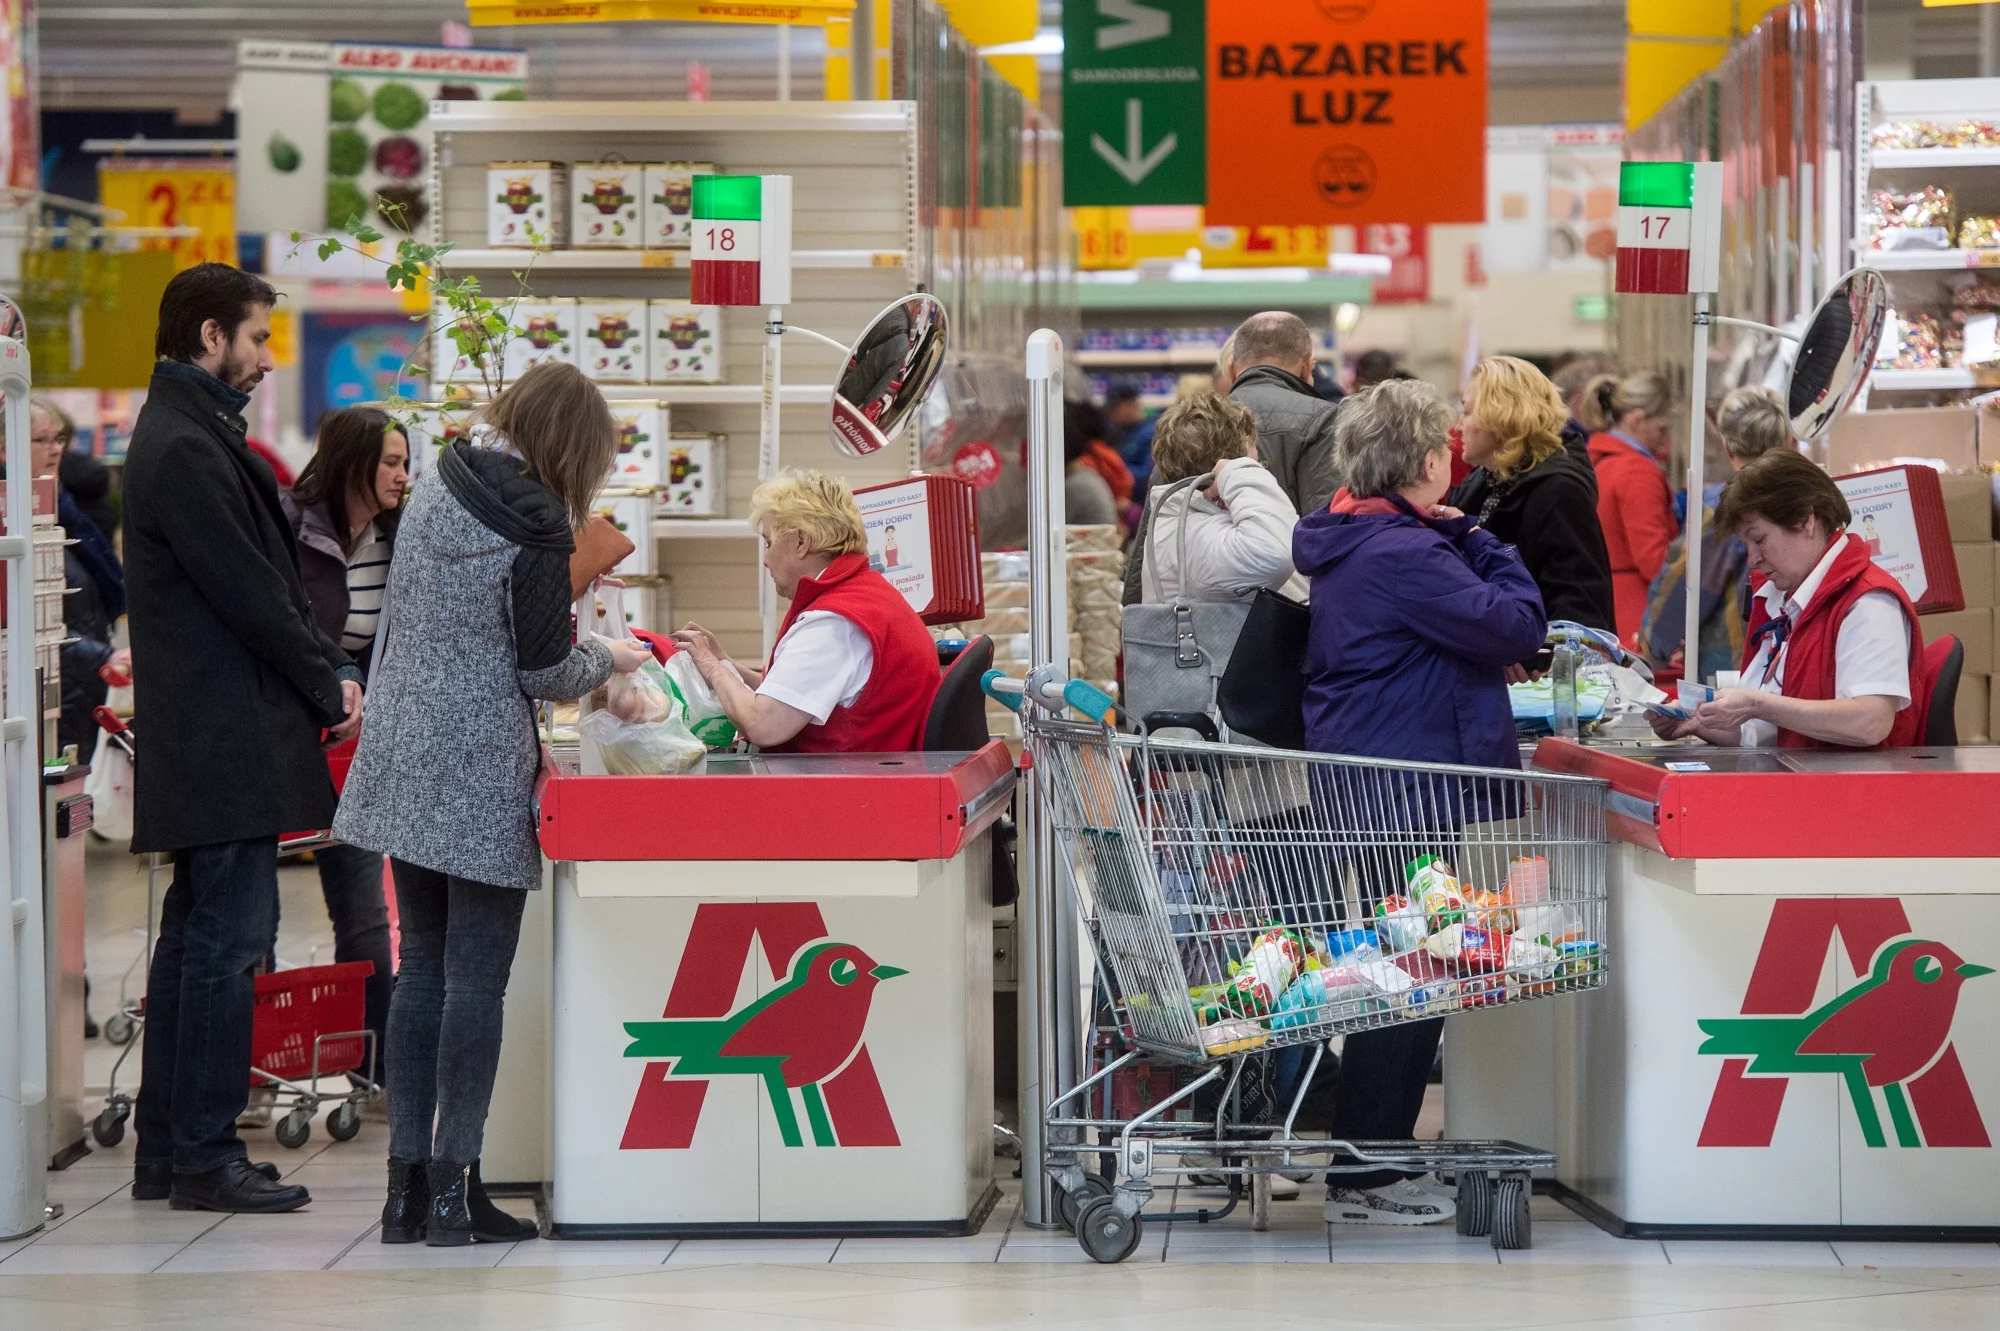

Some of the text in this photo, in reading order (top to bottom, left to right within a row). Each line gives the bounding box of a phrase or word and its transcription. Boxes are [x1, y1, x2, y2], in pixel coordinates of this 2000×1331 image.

[1219, 41, 1469, 79] BAZAREK
[1293, 90, 1393, 125] LUZ
[1641, 216, 1670, 239] 17
[706, 228, 735, 251] 18
[1874, 485, 1884, 493] DO
[1885, 482, 1902, 490] KASY
[897, 496, 906, 504] DO
[907, 493, 922, 502] KASY
[1862, 501, 1893, 514] DOBRY
[864, 513, 913, 529] ZIEŃ DOBRY
[896, 573, 925, 586] posiada
